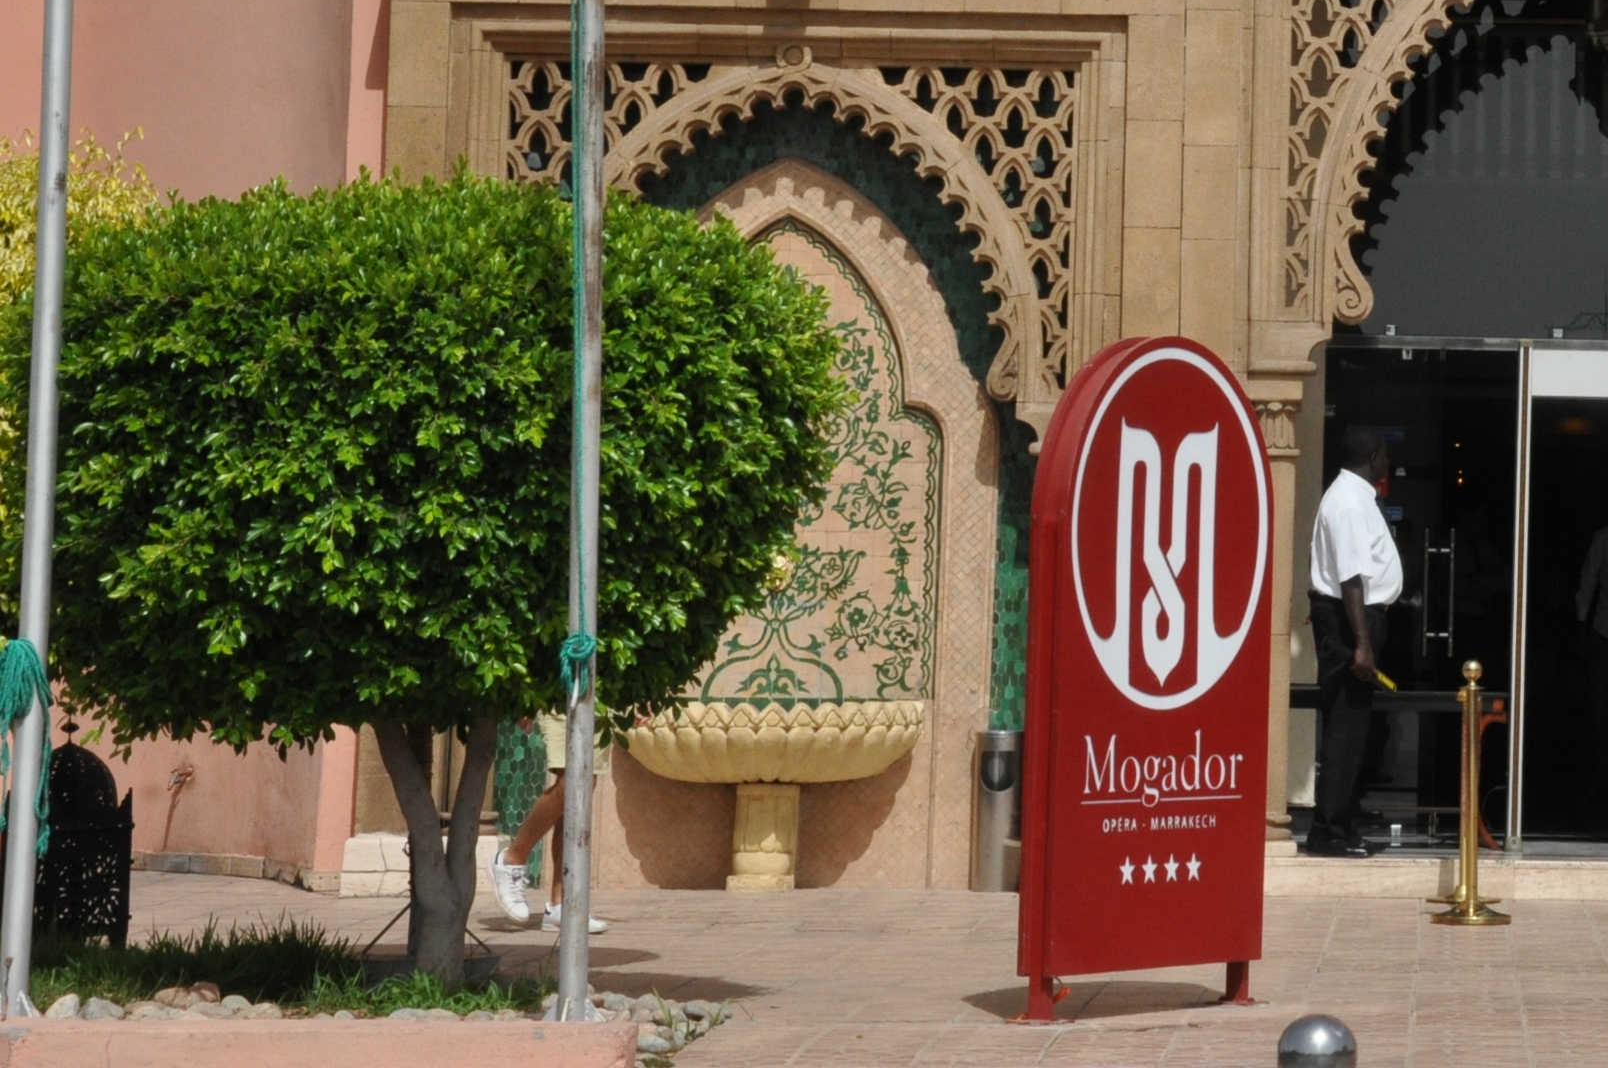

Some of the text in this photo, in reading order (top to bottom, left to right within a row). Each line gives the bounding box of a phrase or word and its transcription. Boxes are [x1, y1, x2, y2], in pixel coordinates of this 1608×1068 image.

[1083, 729, 1244, 808] Mogador
[1102, 816, 1138, 833] OPÉRA
[1150, 814, 1217, 831] MARRAKECH
